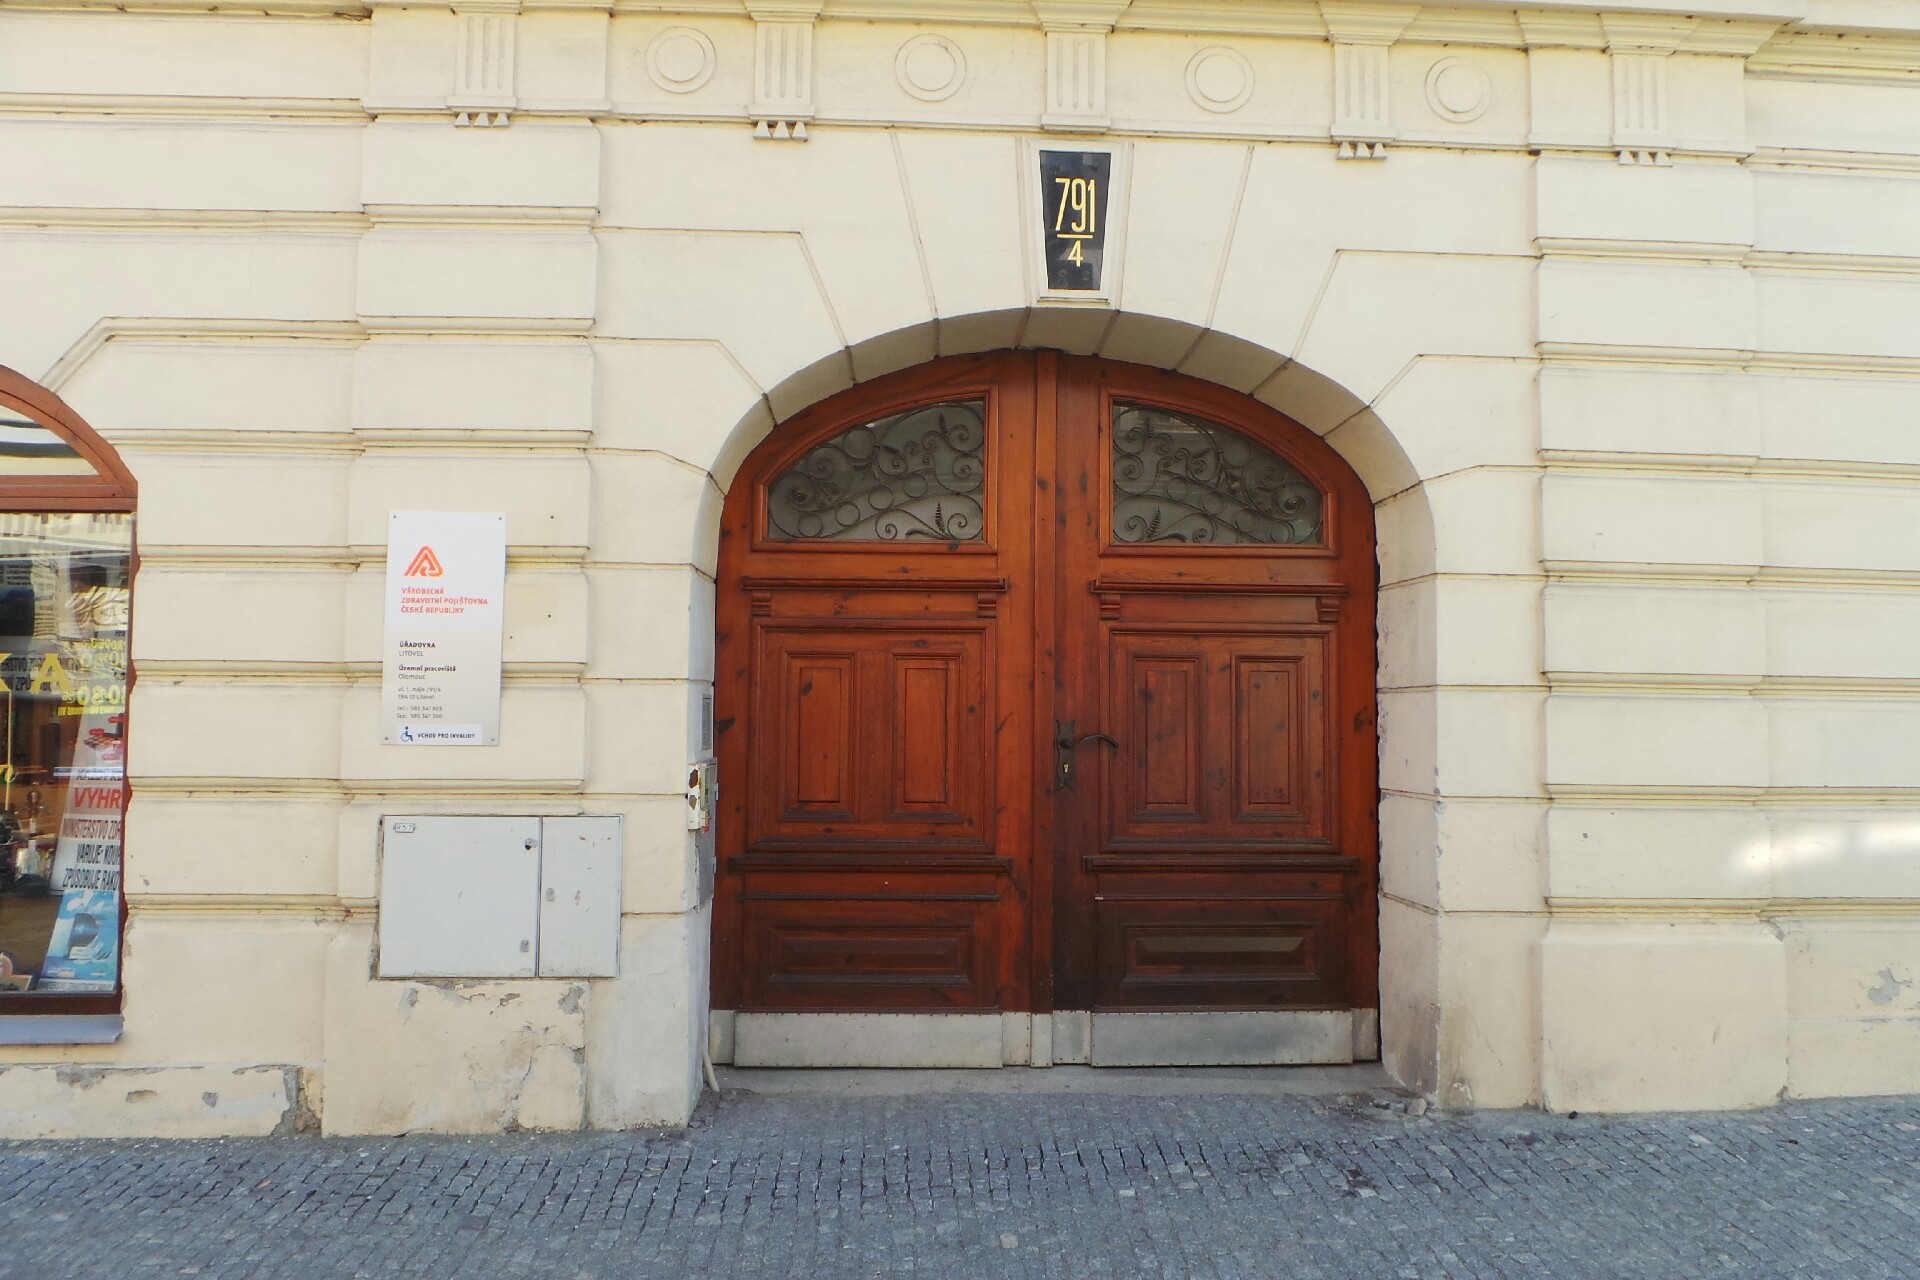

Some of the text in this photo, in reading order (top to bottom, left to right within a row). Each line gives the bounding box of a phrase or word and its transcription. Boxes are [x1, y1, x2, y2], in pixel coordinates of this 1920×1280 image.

[1055, 177, 1096, 233] 791
[1067, 240, 1084, 267] 4
[401, 605, 465, 614] ČESKÉ REPUBLIKY
[444, 597, 488, 605] POJIŠŤOVNA
